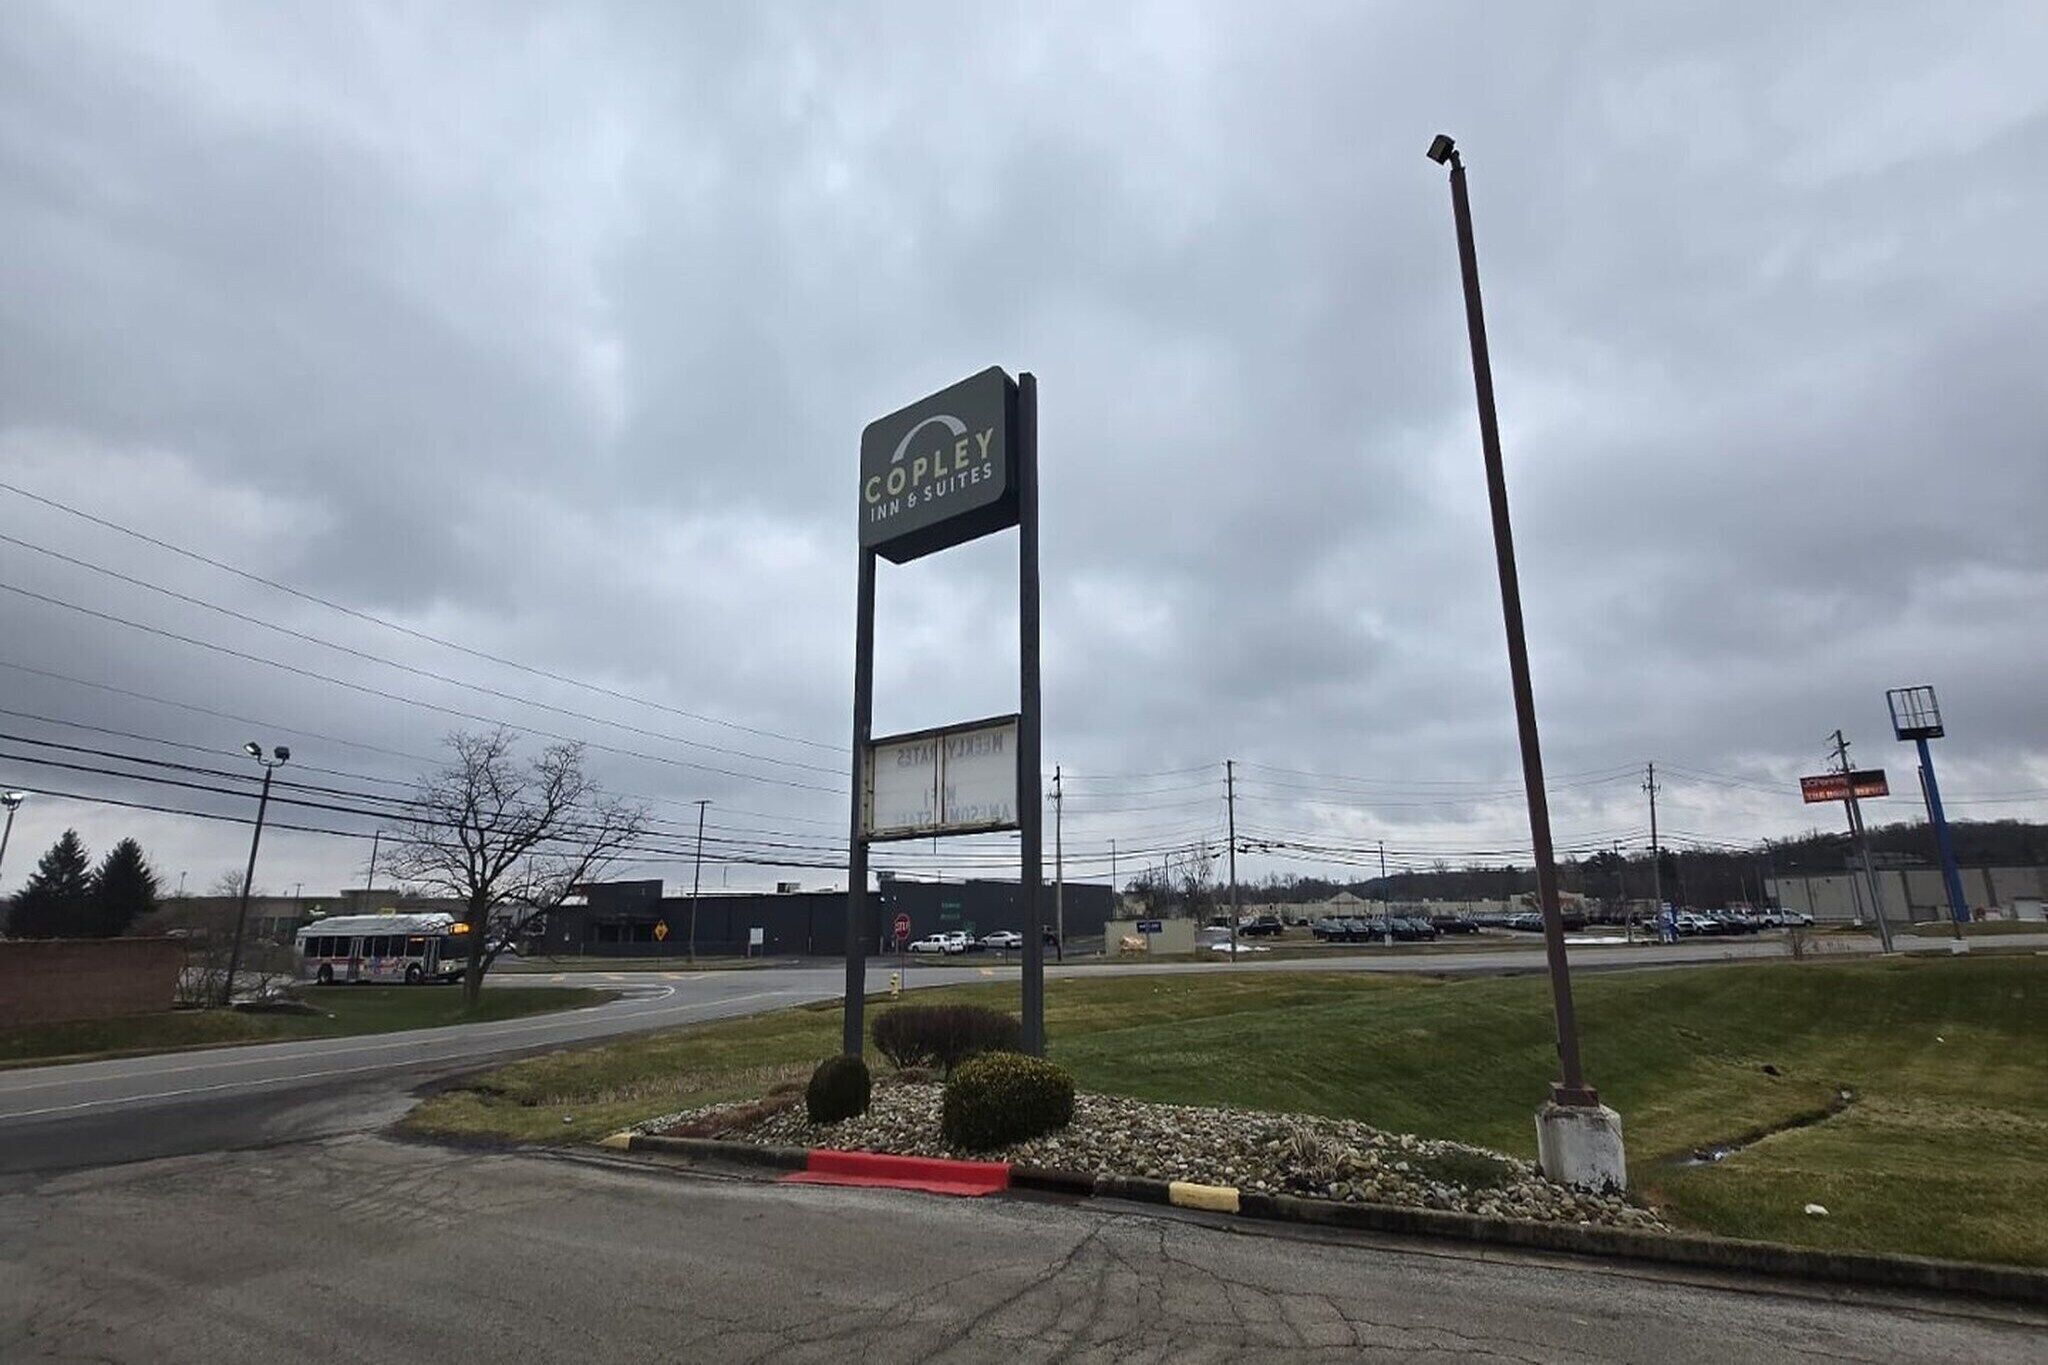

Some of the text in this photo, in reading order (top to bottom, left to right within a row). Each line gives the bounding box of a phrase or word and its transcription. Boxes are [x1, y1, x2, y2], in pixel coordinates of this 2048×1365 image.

[865, 428, 993, 503] COPLEY
[870, 462, 993, 523] INN & SUITES
